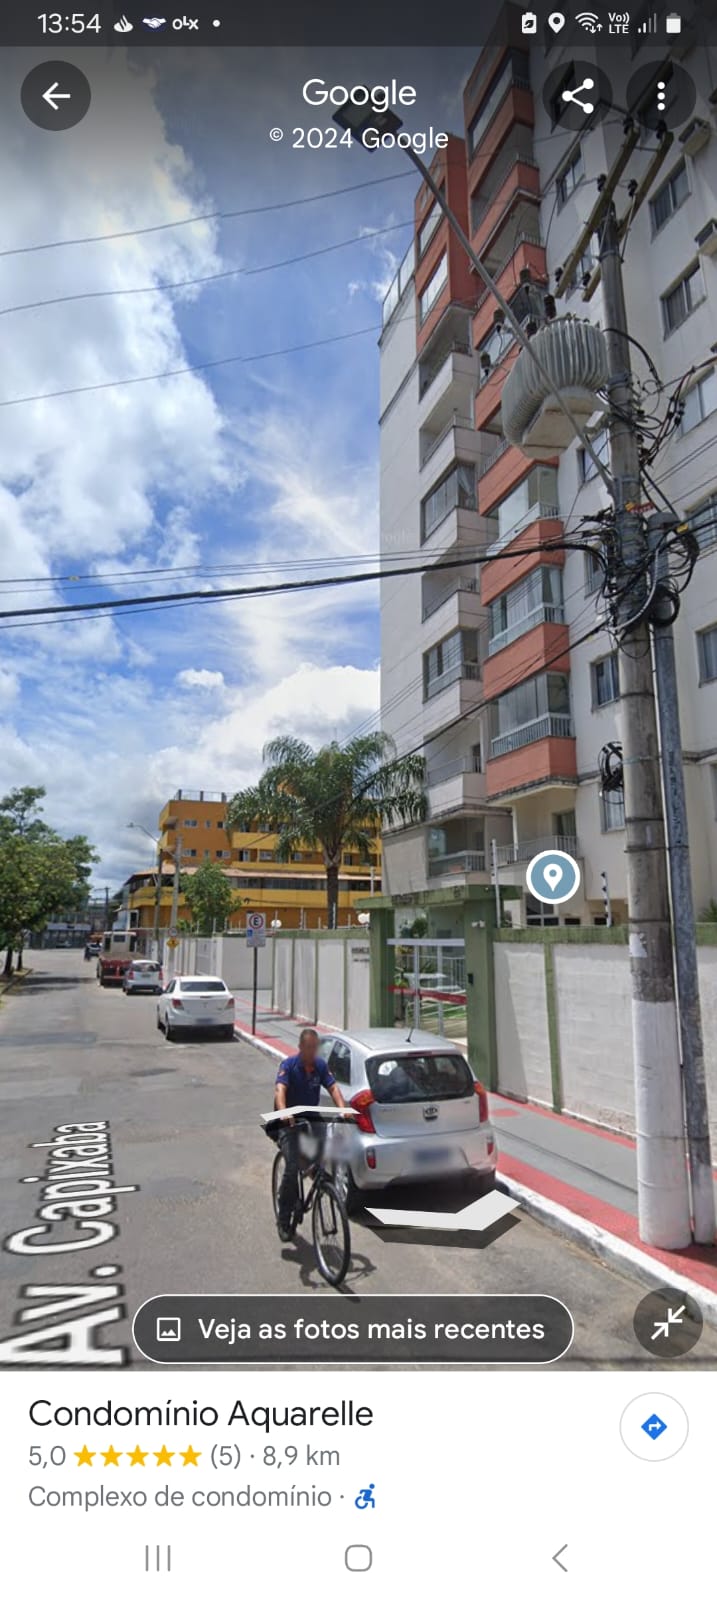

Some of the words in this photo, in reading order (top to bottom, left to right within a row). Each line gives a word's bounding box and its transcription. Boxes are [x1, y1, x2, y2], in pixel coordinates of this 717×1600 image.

[38, 13, 102, 34] 13:54
[609, 24, 630, 34] LTE
[198, 1318, 251, 1345] Veja
[259, 1324, 286, 1340] as
[294, 1318, 360, 1340] fotos
[368, 1318, 427, 1340] mais
[434, 1320, 545, 1340] recentes
[29, 1399, 219, 1427] Condomínio
[228, 1400, 374, 1434] Aquarelle
[29, 1446, 66, 1469] 5,0
[211, 1444, 241, 1470] (5)
[264, 1446, 298, 1469] 8,9
[307, 1444, 341, 1466] km
[29, 1485, 148, 1513] Complexo
[155, 1485, 185, 1507] de
[192, 1485, 332, 1507] condomínio
